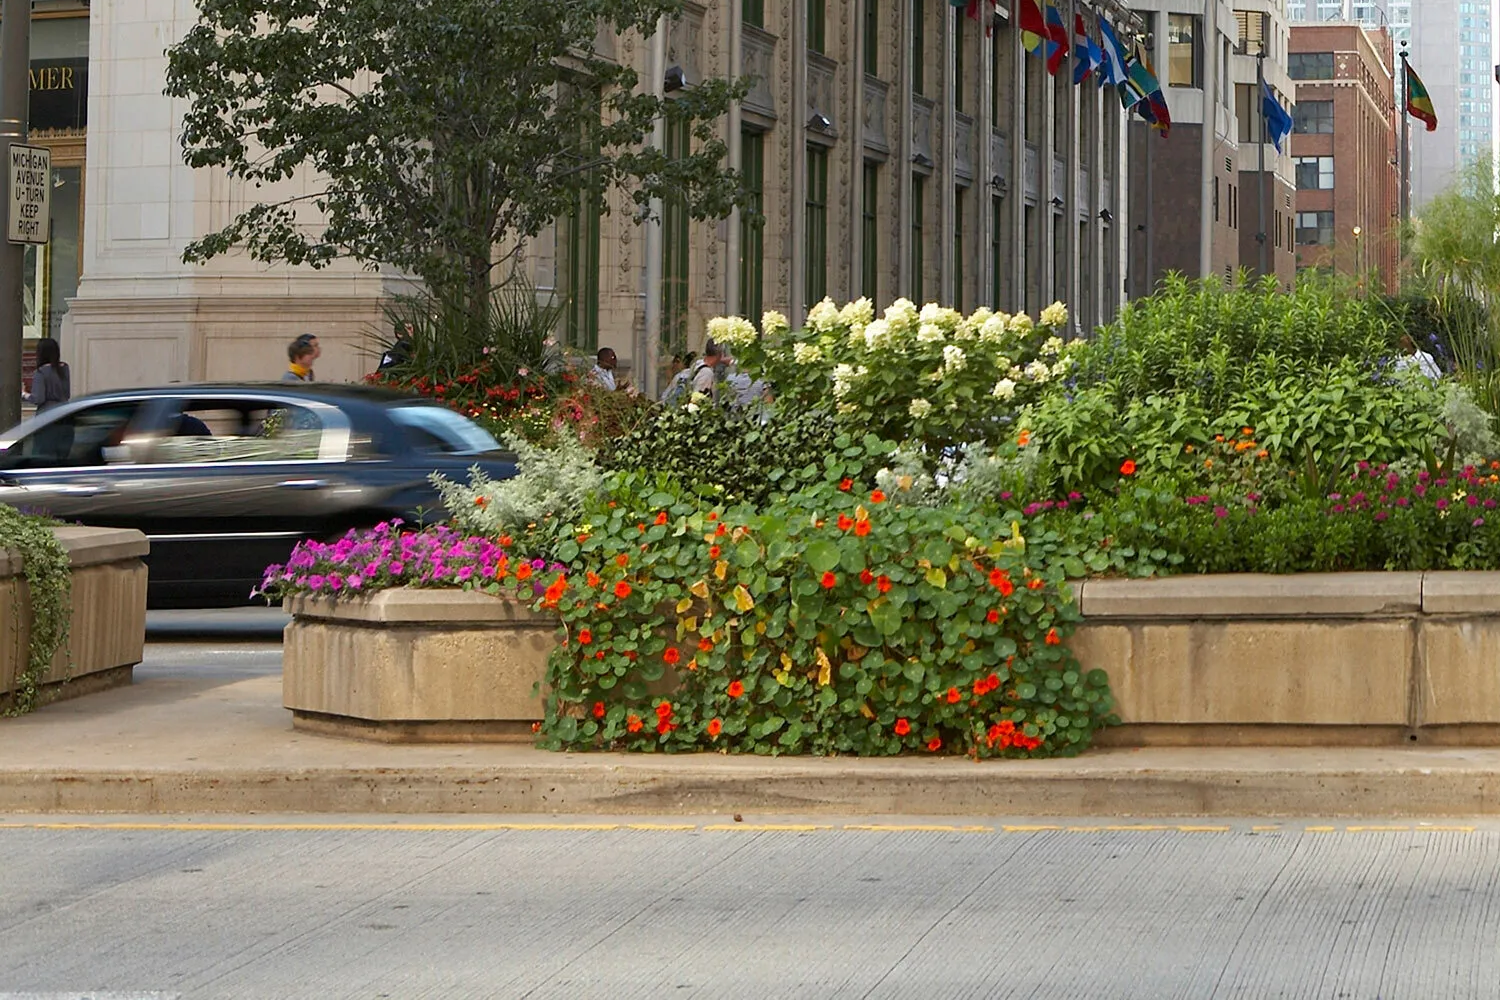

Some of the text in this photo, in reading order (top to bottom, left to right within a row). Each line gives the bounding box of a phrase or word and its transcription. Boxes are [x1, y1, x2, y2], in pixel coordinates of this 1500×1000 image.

[13, 152, 48, 169] MICHIGAN
[16, 171, 45, 186] AVENUE
[15, 186, 45, 203] U-TURN
[20, 203, 39, 218] KEEP
[18, 220, 39, 236] RIGHT
